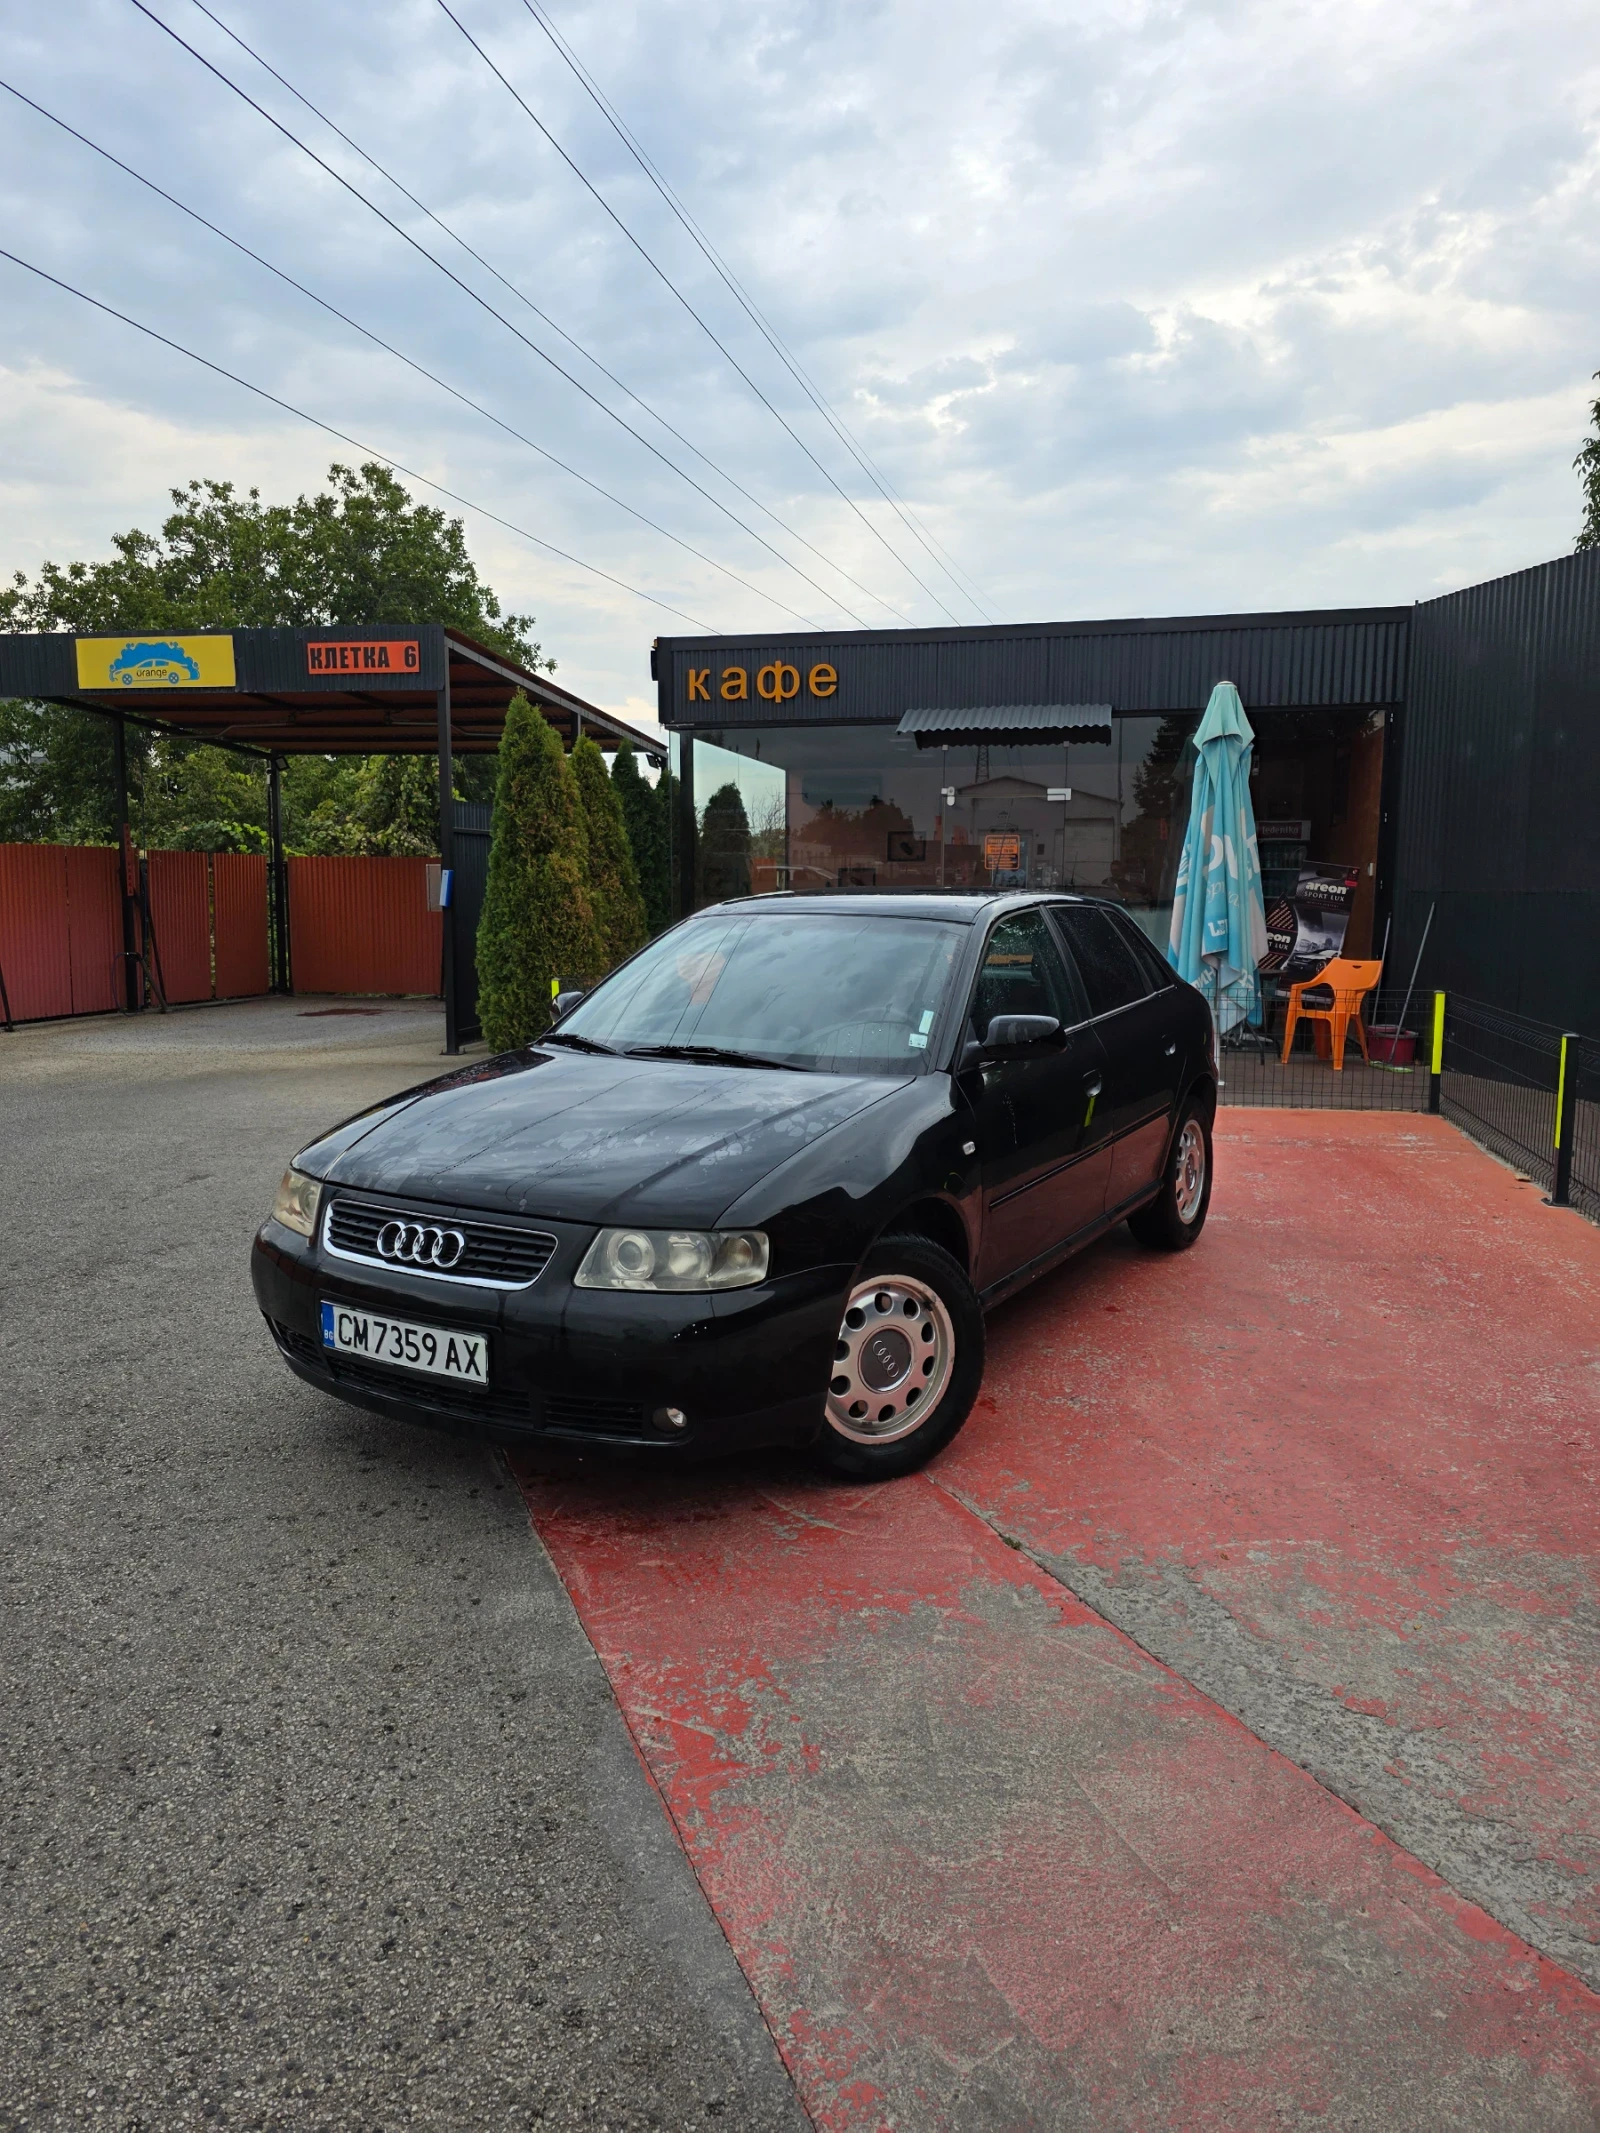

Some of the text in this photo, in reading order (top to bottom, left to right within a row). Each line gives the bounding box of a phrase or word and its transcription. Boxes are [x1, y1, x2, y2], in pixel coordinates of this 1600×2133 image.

[310, 645, 417, 669] КЛЕТКА 6
[136, 668, 168, 679] orange
[688, 660, 838, 704] кафе
[1305, 881, 1348, 895] areon
[1304, 891, 1345, 902] SPORT LUX
[1274, 942, 1289, 951] LUX
[323, 1329, 334, 1341] BG
